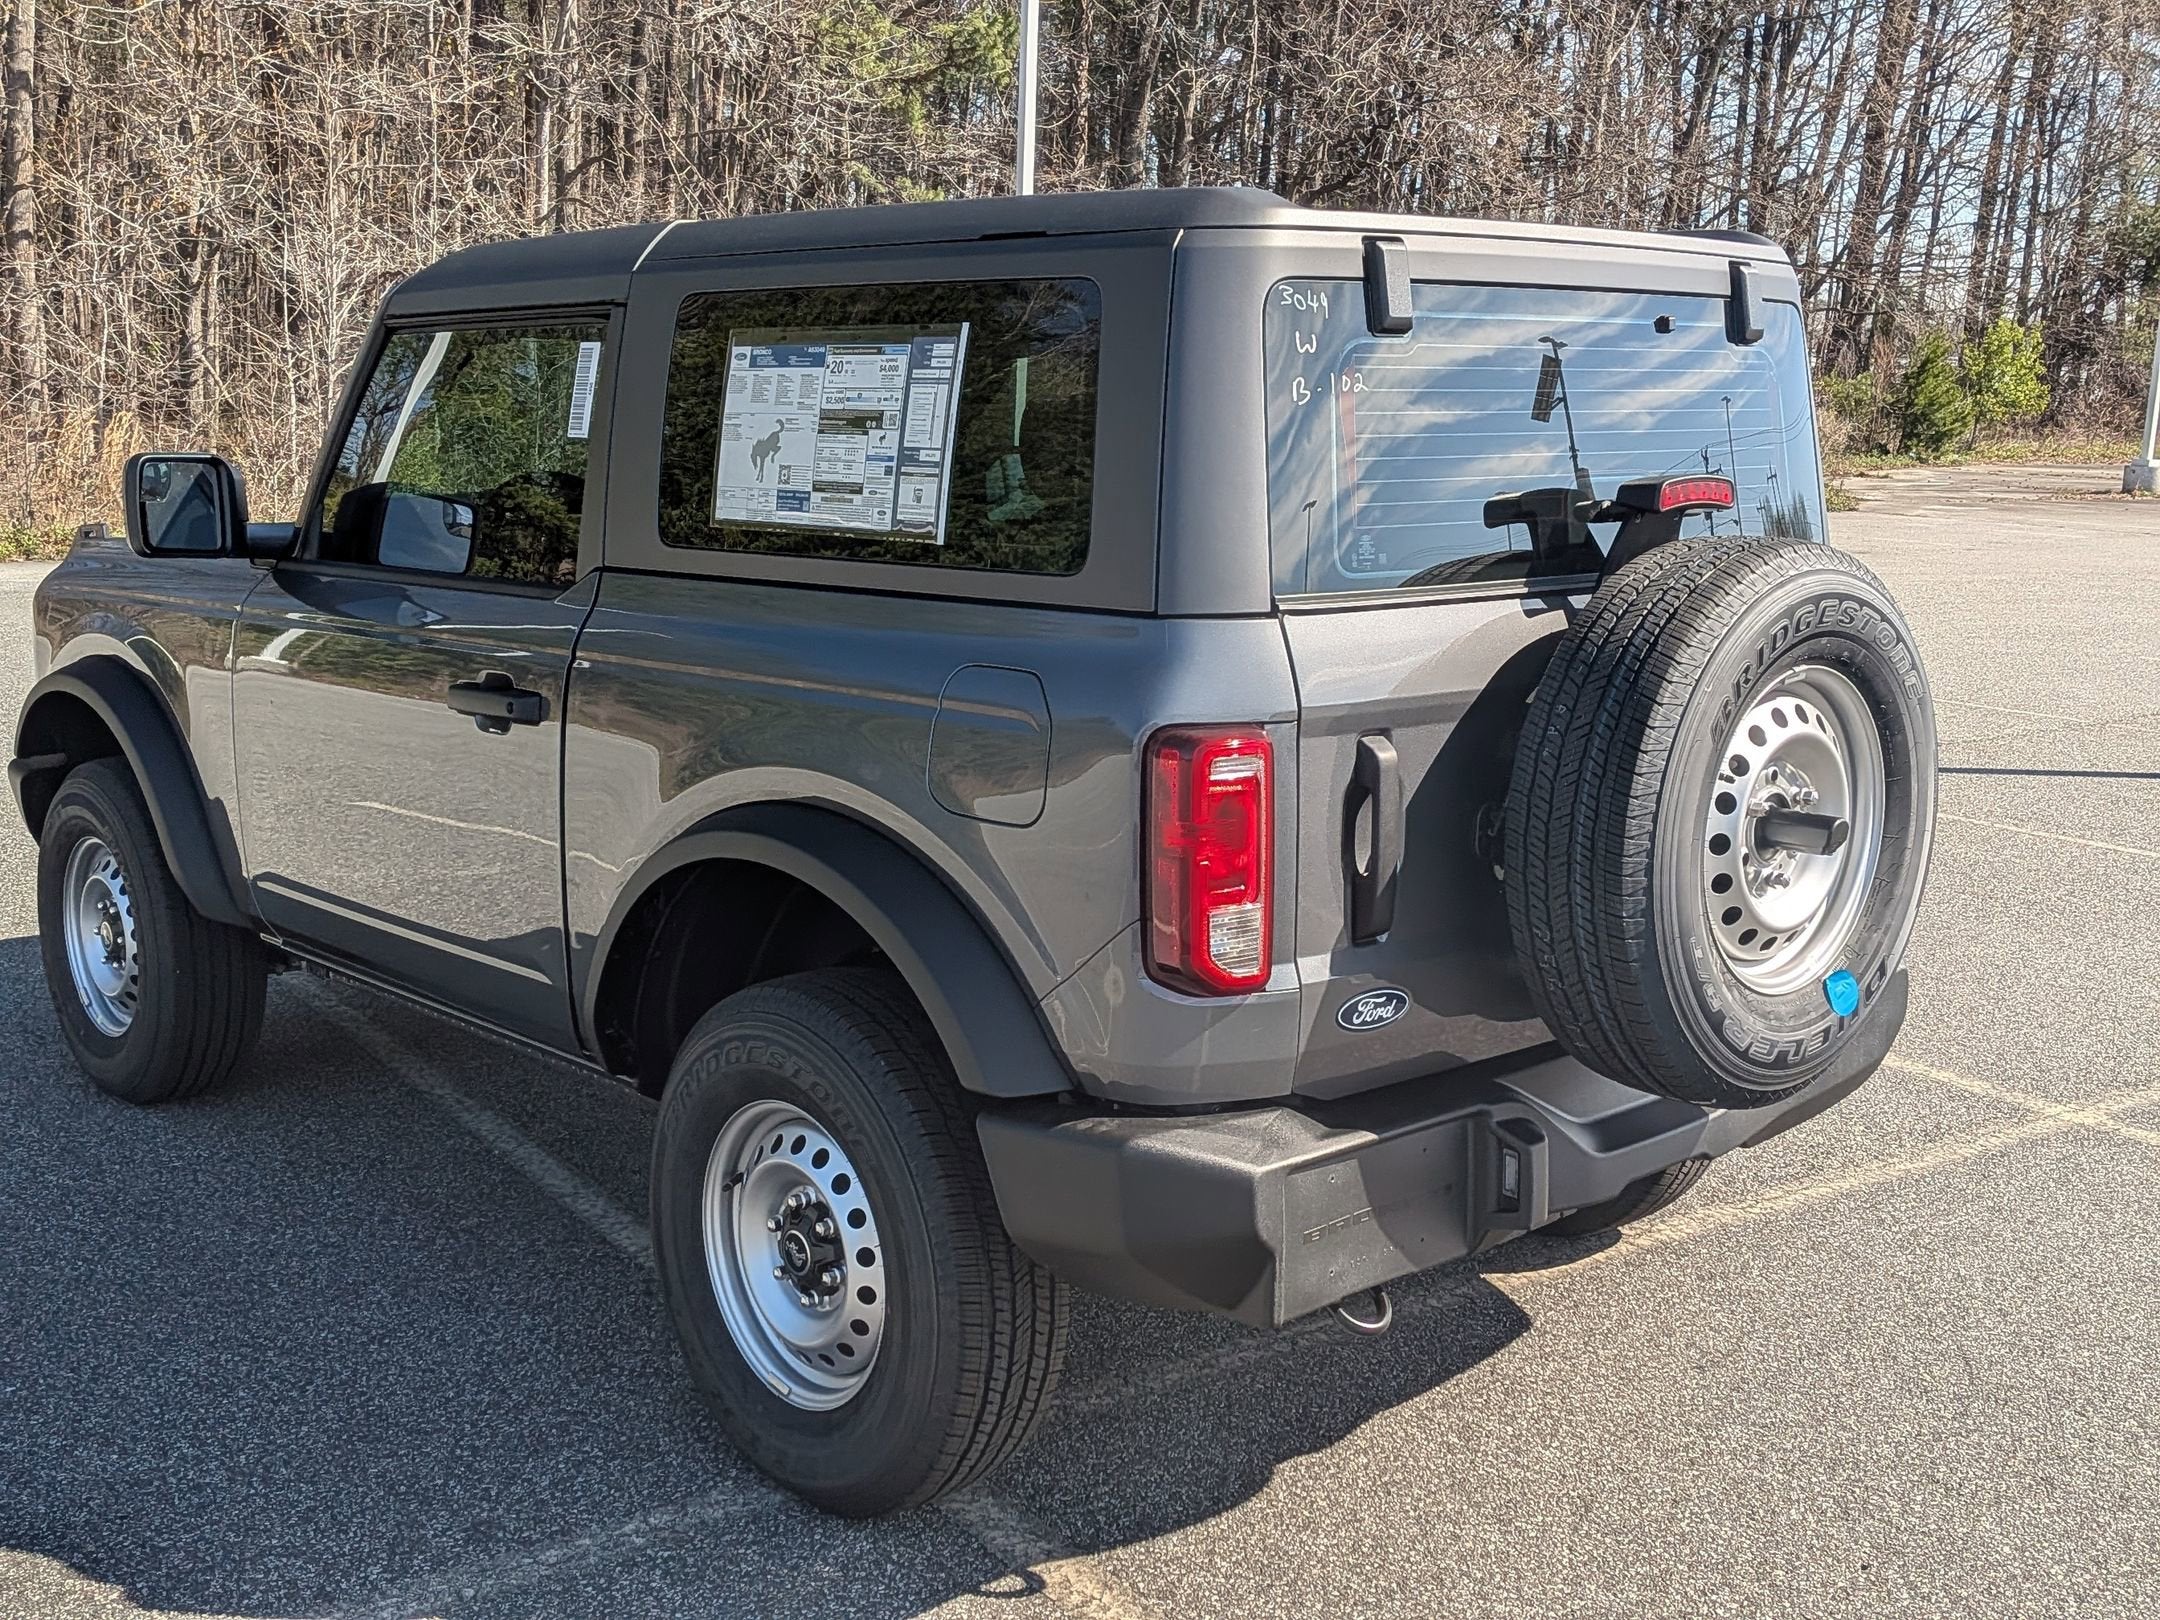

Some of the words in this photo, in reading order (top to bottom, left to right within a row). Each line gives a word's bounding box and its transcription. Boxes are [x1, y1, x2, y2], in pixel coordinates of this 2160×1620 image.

[1278, 284, 1329, 320] 3049
[1295, 330, 1317, 354] W
[830, 360, 844, 374] 20
[879, 364, 900, 374] $4,000
[1710, 598, 1925, 746] BRIDGESTONE
[1352, 995, 1397, 1025] Ford
